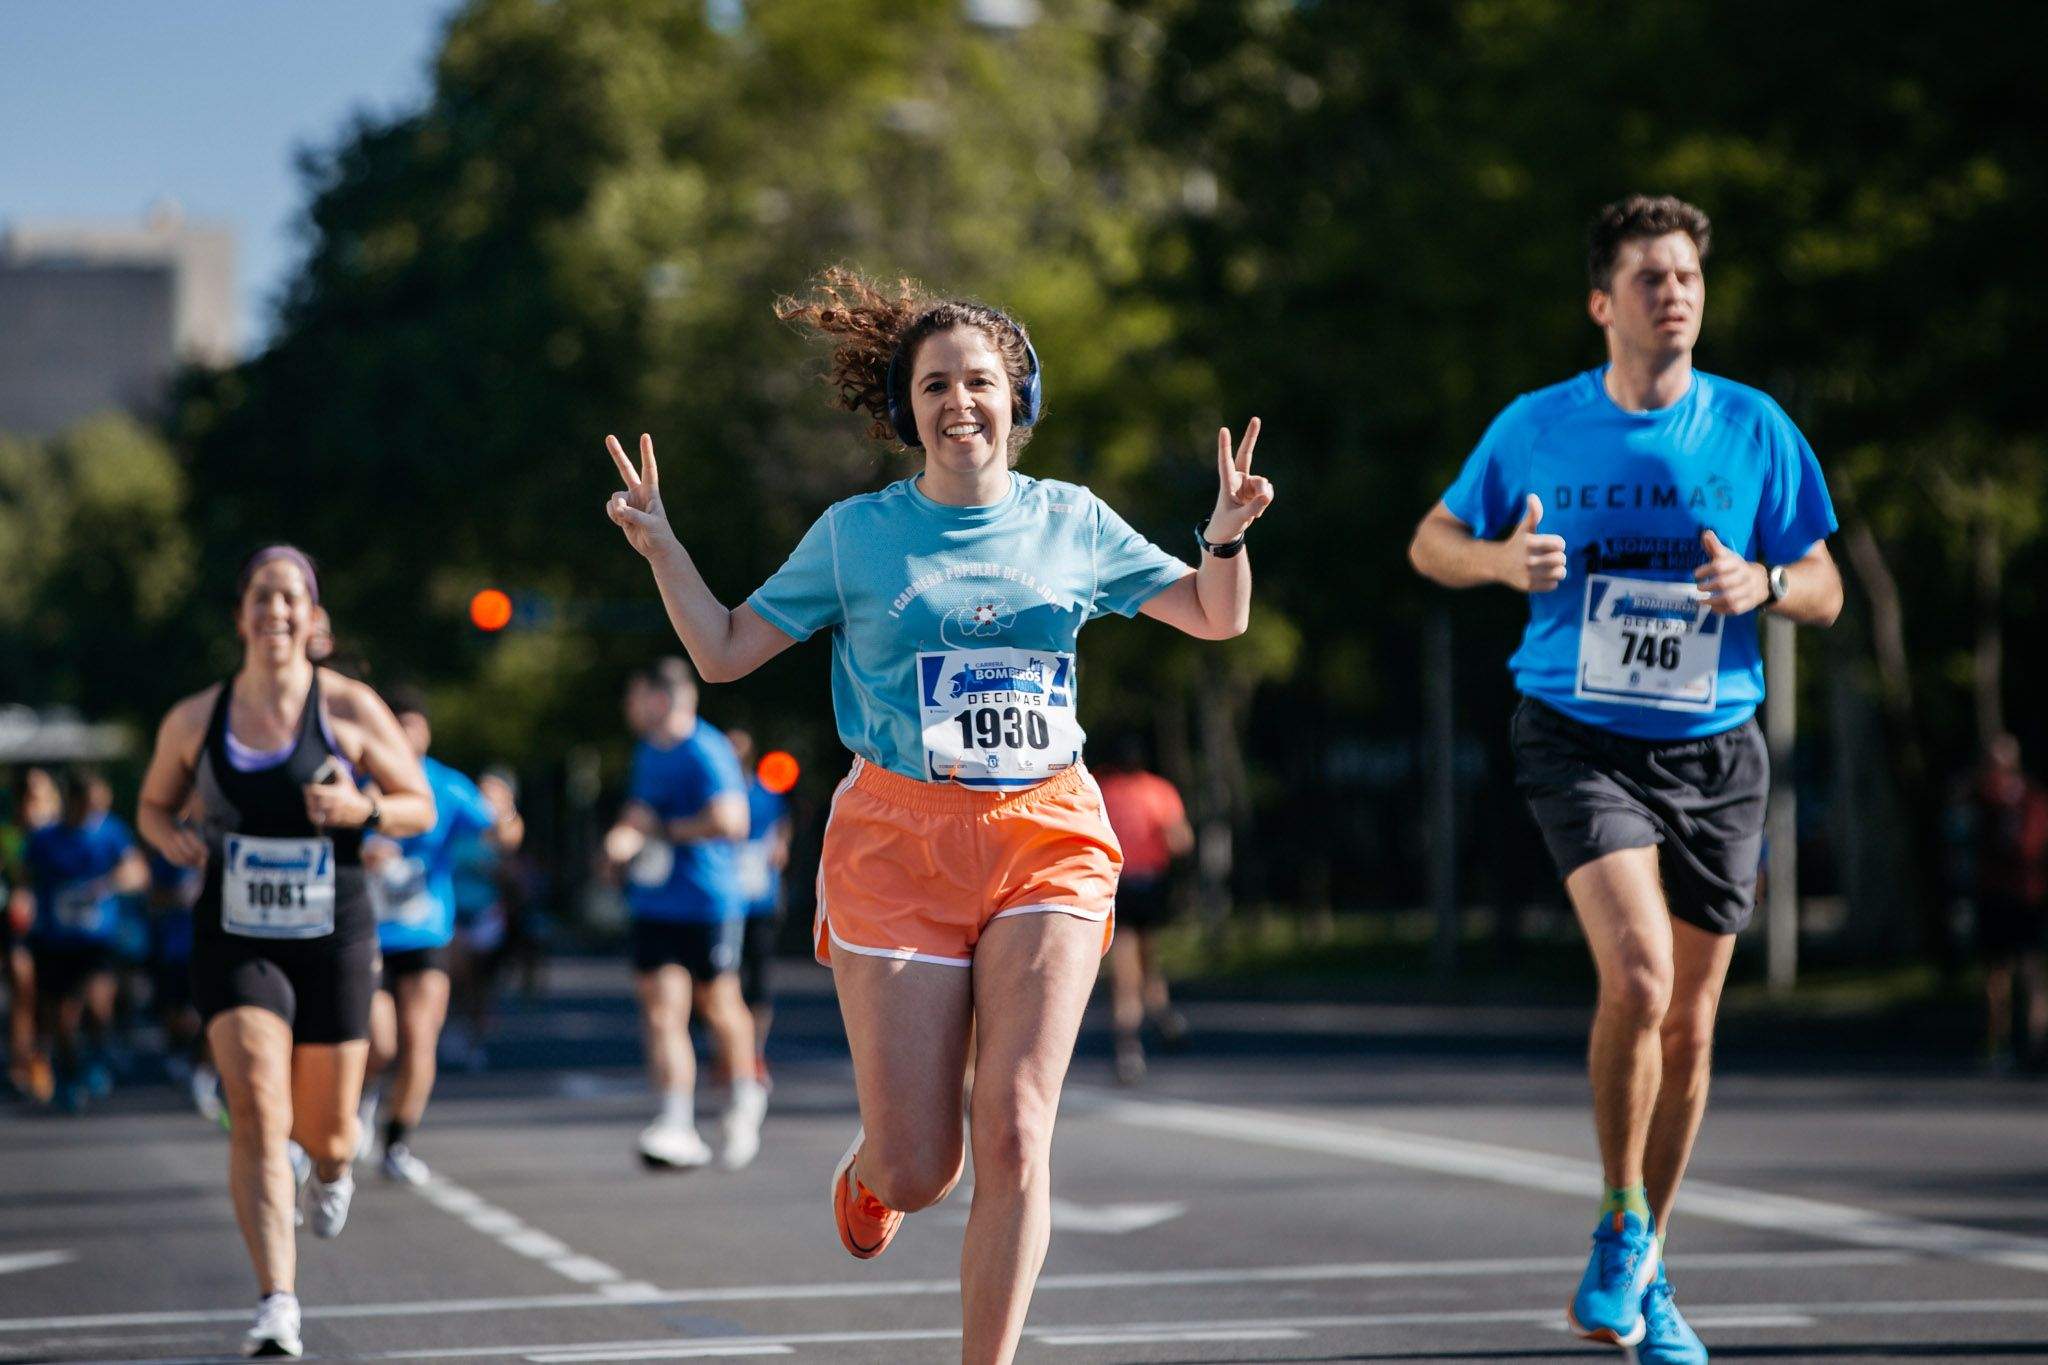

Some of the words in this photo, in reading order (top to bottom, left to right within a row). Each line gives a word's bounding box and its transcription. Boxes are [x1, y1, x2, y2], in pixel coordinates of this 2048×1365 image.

[1555, 483, 1733, 511] DECIMAS
[945, 561, 1001, 581] POPULAR
[1003, 564, 1019, 581] DE
[1021, 572, 1037, 589] LA
[1621, 631, 1682, 671] 746
[975, 667, 1041, 682] BOMBEROS
[968, 692, 1041, 706] DECIMAS
[954, 706, 1050, 751] 1930
[248, 881, 306, 909] 1081
